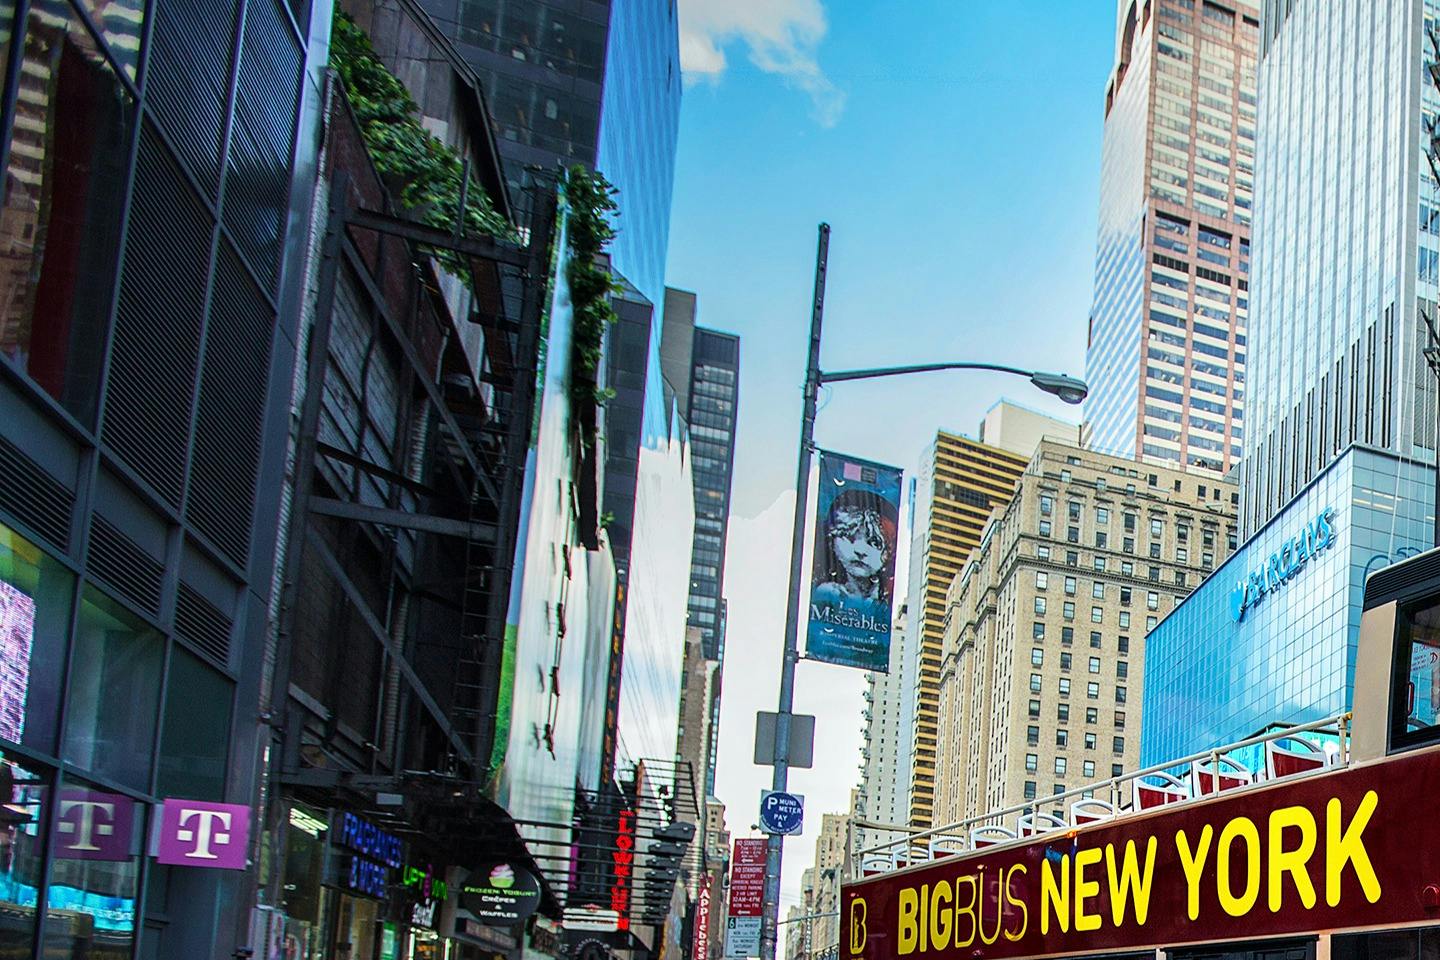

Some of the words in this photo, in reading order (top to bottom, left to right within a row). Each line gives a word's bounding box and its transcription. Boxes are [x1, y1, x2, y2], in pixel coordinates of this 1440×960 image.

[1246, 506, 1335, 606] BARCLAYS
[809, 603, 889, 633] Misérables
[767, 796, 779, 810] P
[779, 798, 797, 806] MUNI
[778, 805, 802, 815] METER
[773, 813, 788, 822] PAY
[1040, 835, 1158, 936] NEW
[1175, 789, 1383, 922] YORK
